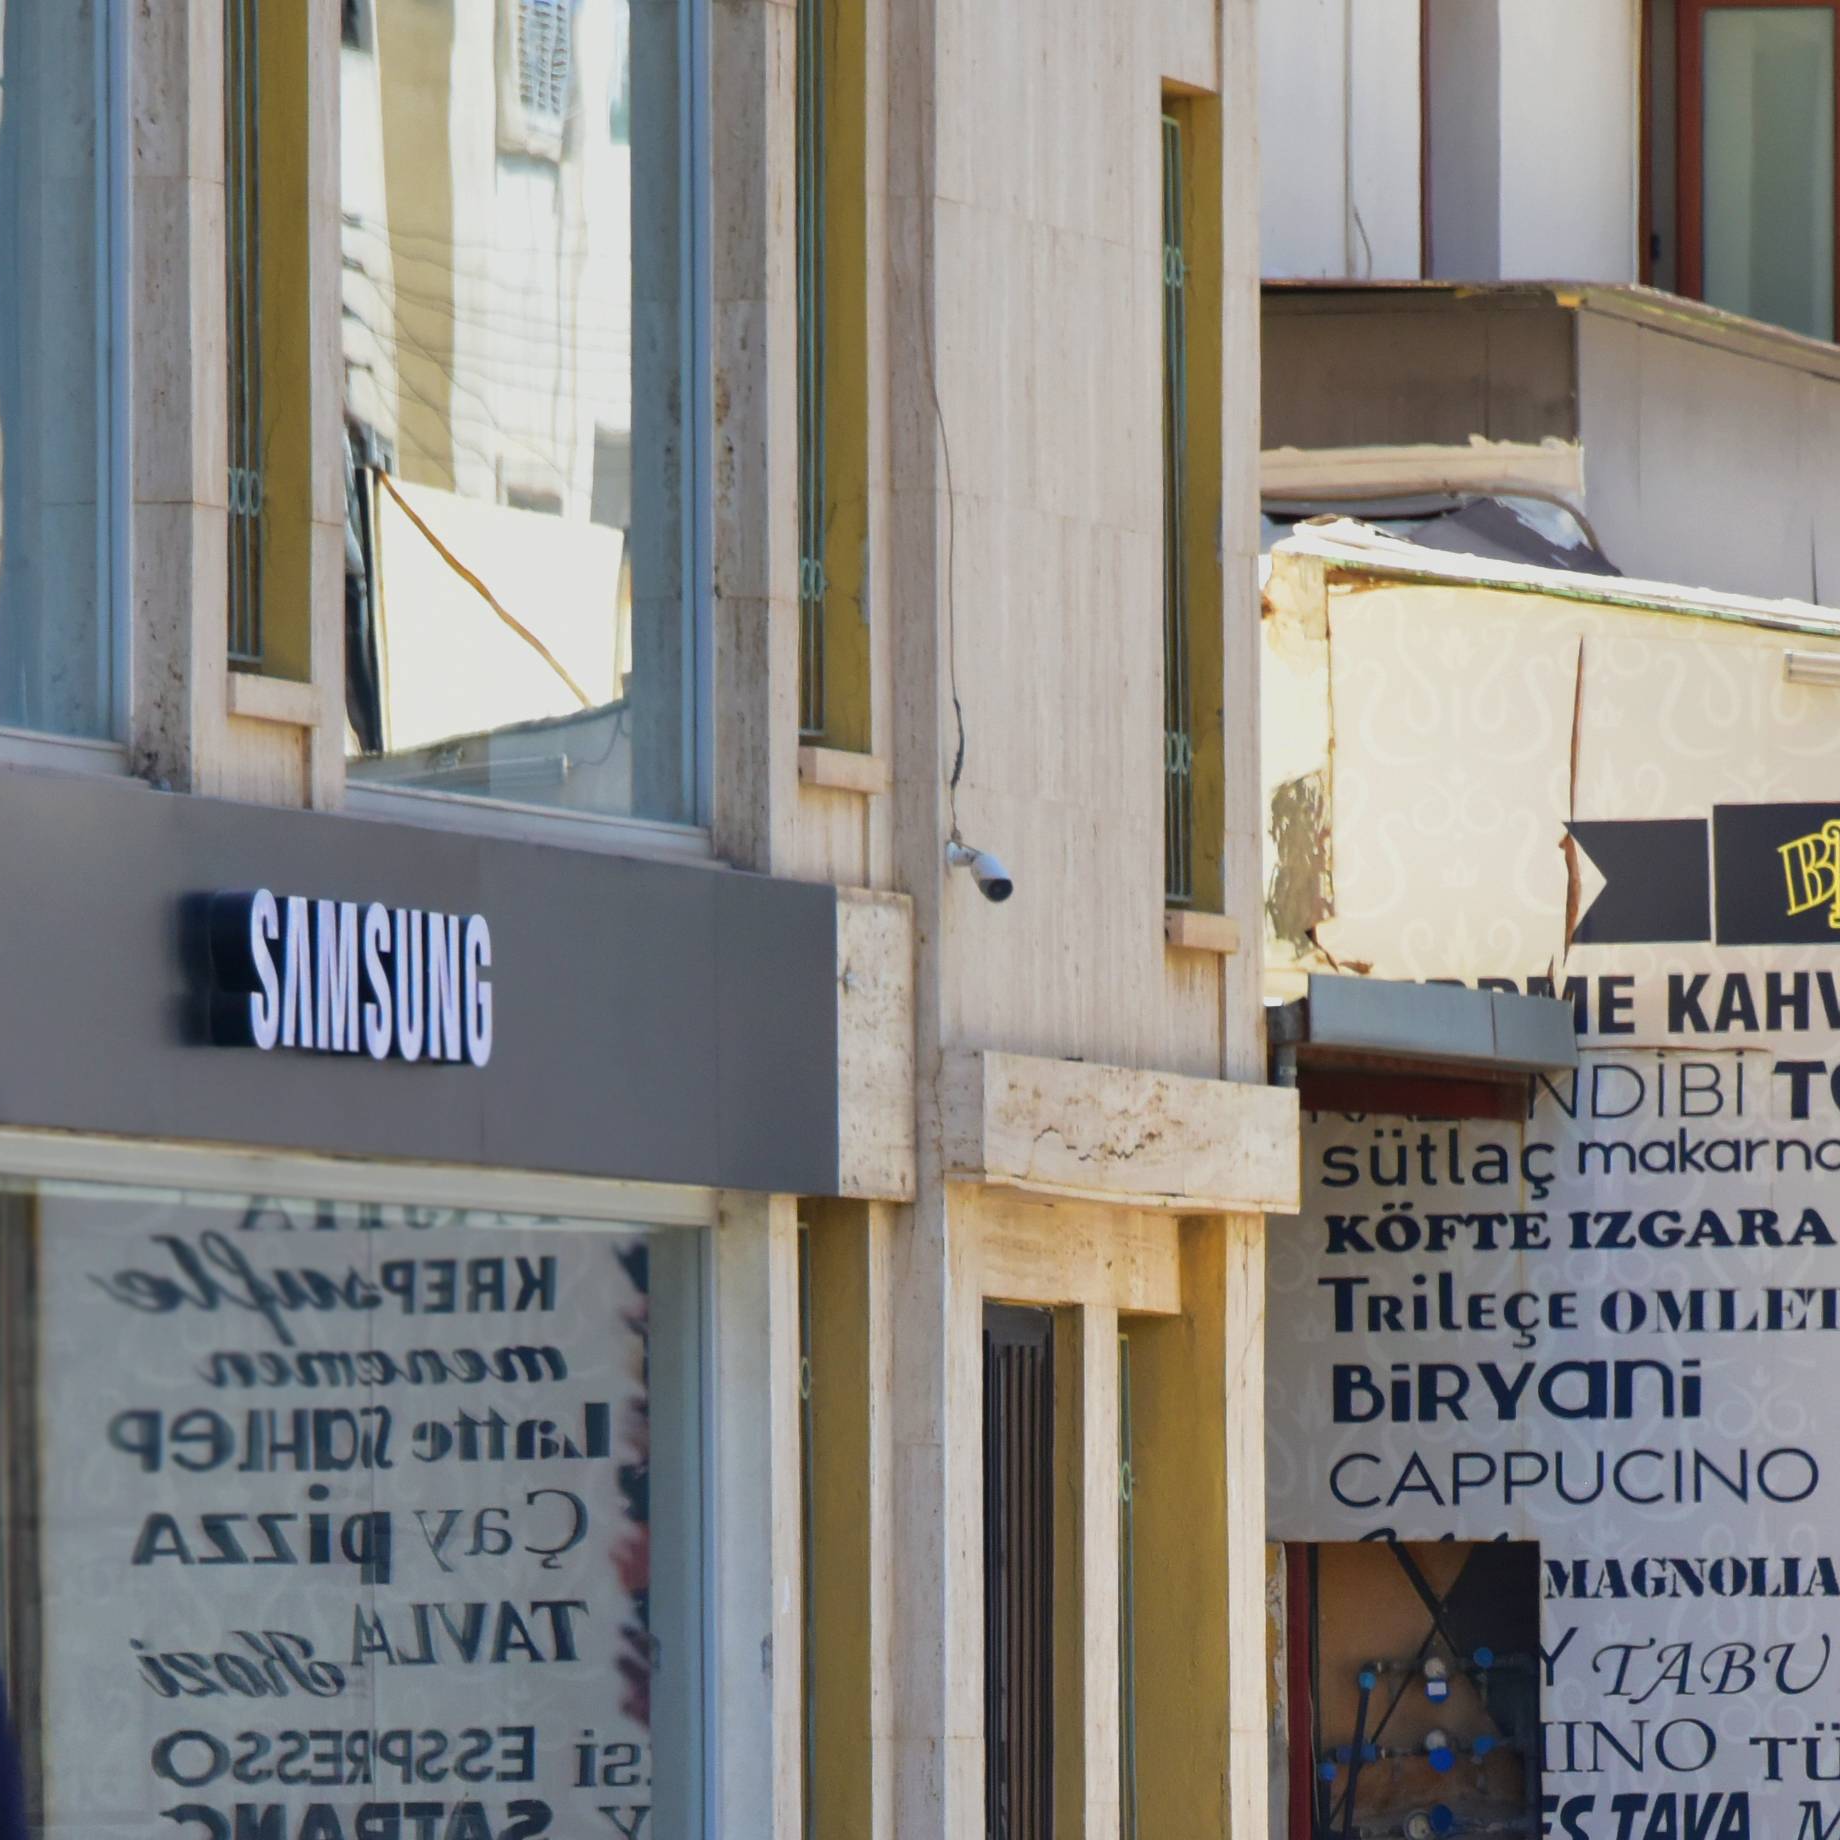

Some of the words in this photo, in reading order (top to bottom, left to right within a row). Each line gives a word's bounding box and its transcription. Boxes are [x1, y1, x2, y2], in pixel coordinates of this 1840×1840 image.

[250, 888, 492, 1068] SAMSUNG
[1321, 1128, 1555, 1200] sütlaç
[1324, 1201, 1551, 1254] KÖFTE
[1568, 1208, 1837, 1250] IZGARA
[1329, 1447, 1819, 1508] CAPPUCINO
[1544, 1556, 1840, 1599] MAGNOLIA
[1592, 1634, 1832, 1704] TABU
